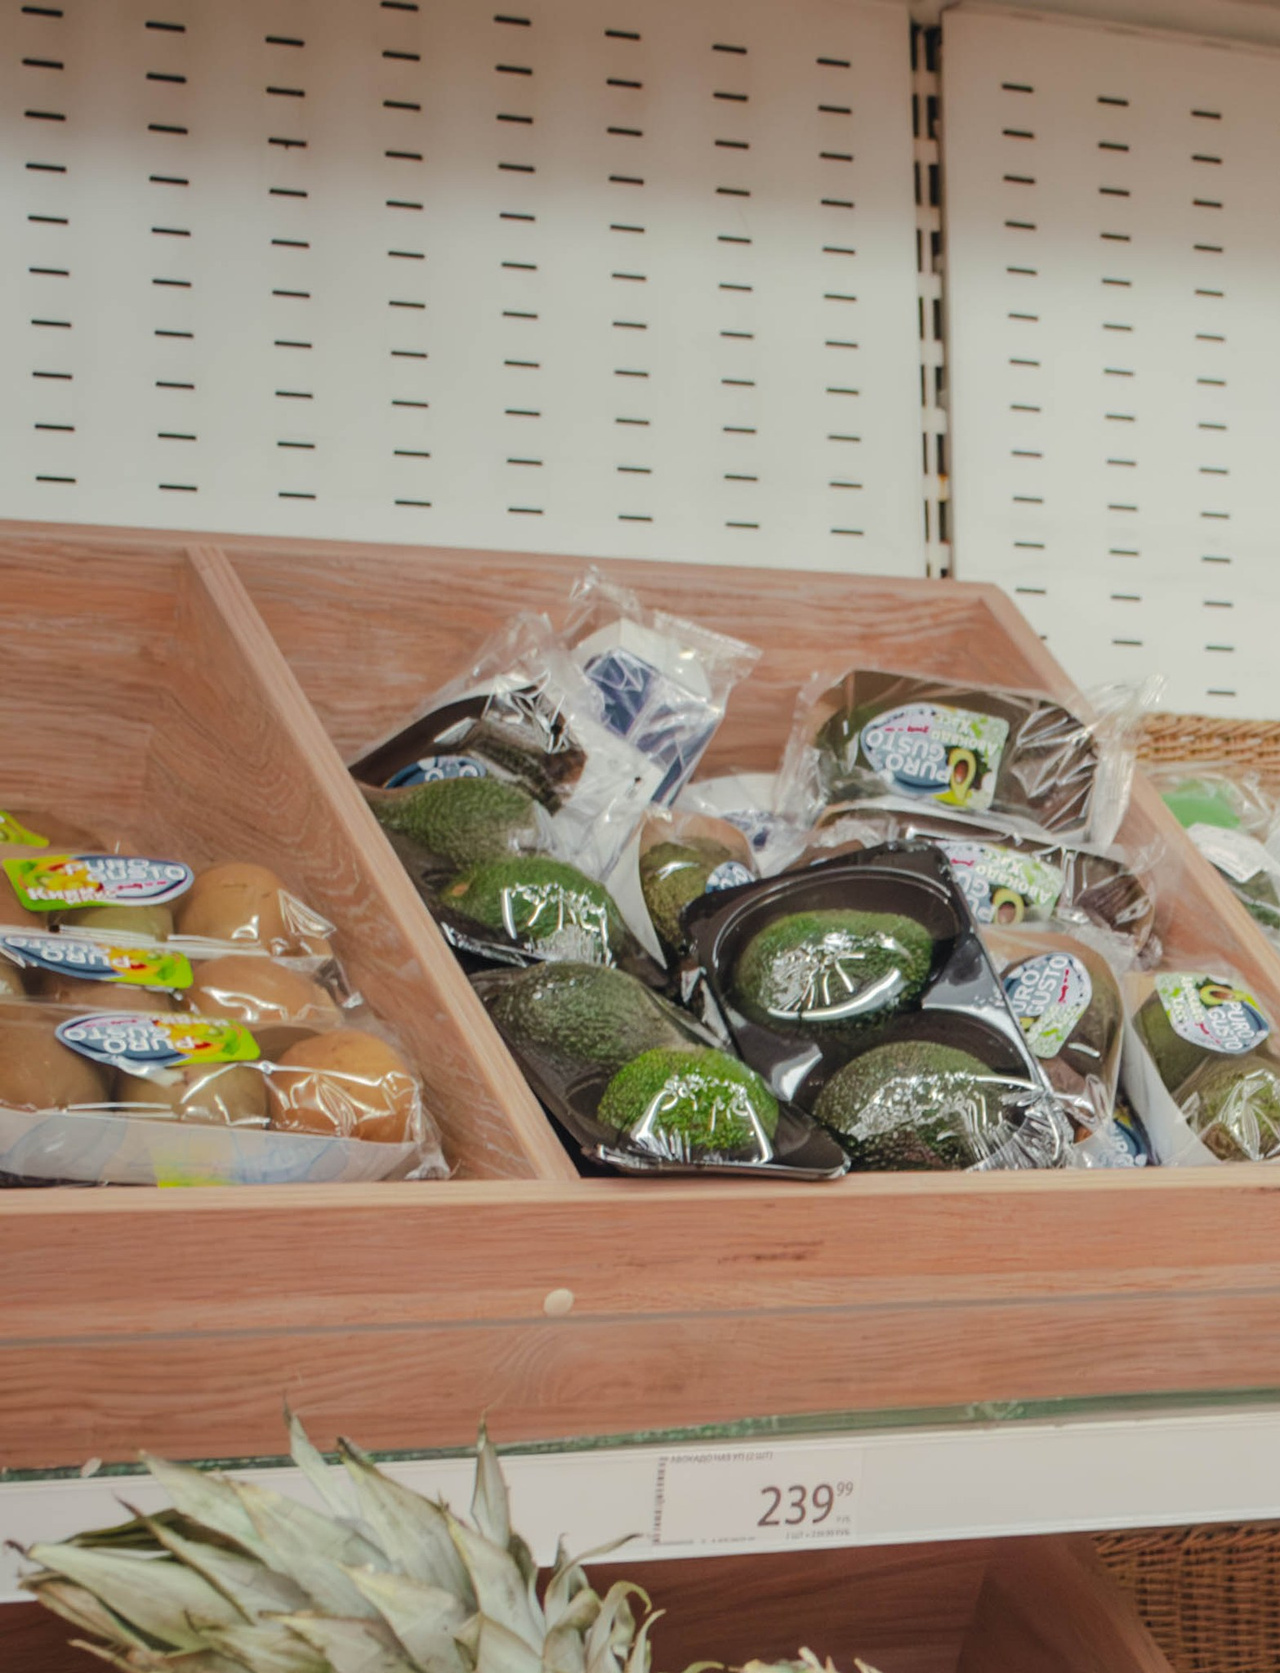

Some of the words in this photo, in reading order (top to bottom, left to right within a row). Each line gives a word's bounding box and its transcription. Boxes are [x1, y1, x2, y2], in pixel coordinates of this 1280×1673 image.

[866, 730, 945, 762] GUSTO
[885, 753, 951, 784] PURO
[63, 858, 150, 876] PURO
[40, 948, 131, 968] PURO
[1012, 969, 1040, 1013] URO
[1026, 955, 1069, 1015] GUSTO
[64, 1026, 171, 1041] GUSTO
[1208, 1008, 1243, 1050] GUSTO
[1228, 1001, 1255, 1038] PURO
[103, 1036, 195, 1053] PURO
[757, 1483, 834, 1527] 239
[836, 1481, 854, 1497] 99
